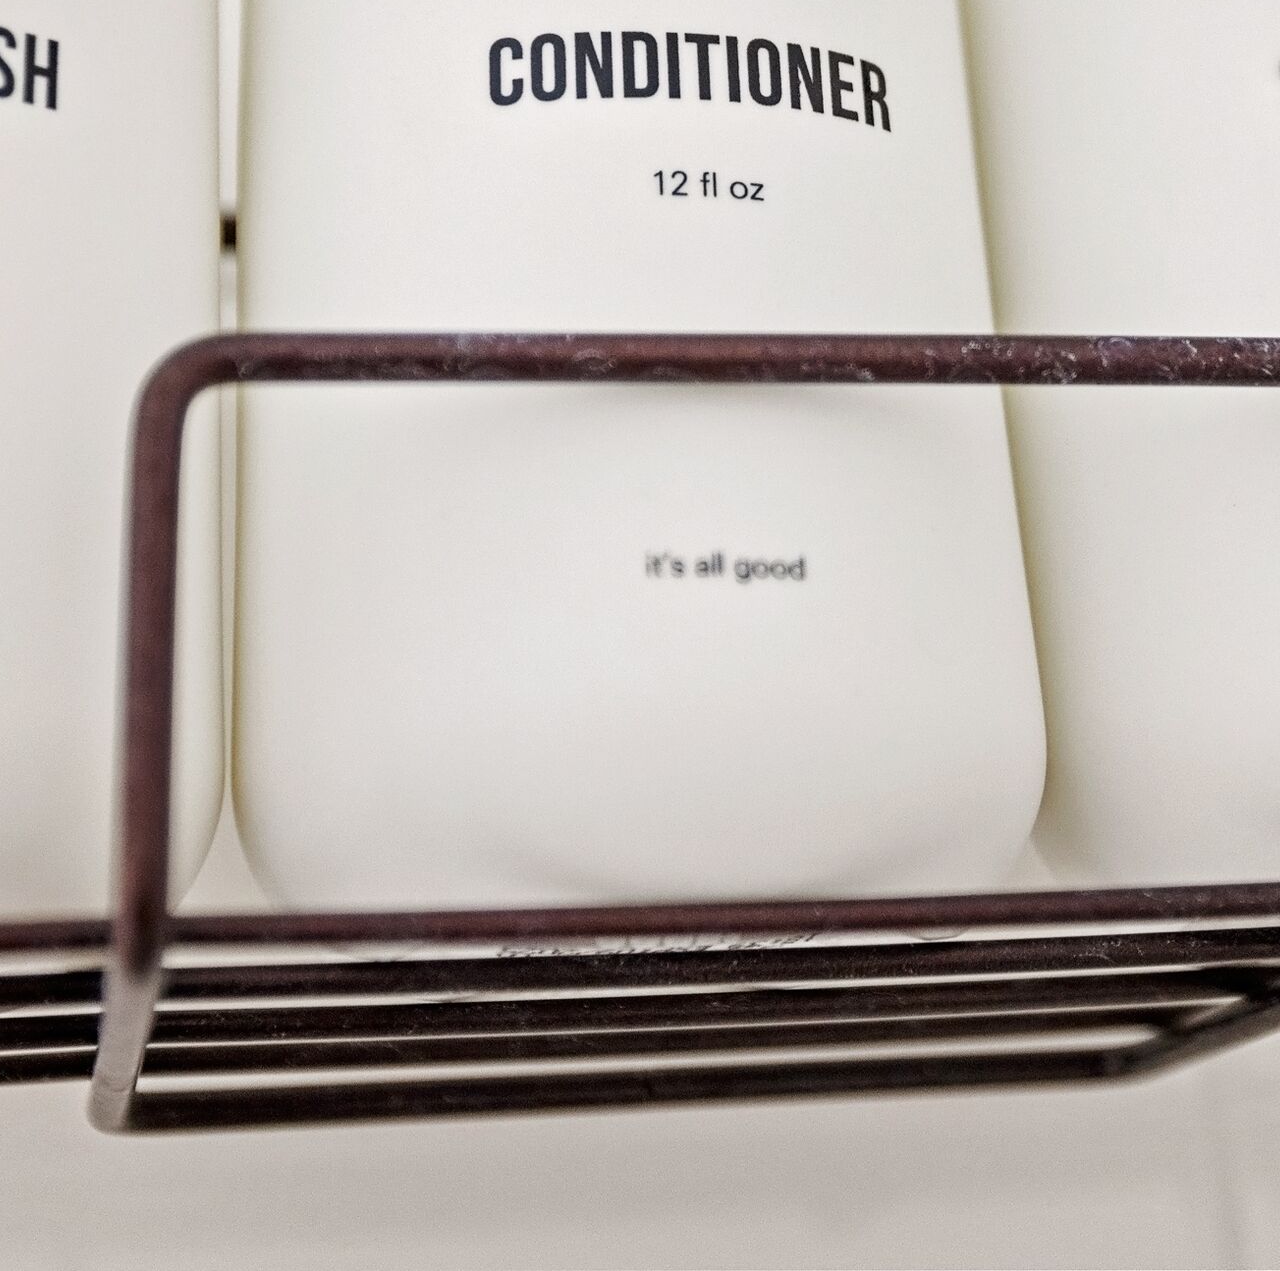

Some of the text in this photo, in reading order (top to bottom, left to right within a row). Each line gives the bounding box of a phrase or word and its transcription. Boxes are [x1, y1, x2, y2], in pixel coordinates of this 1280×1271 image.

[487, 30, 893, 133] CONDITIONER
[652, 169, 767, 203] 12 fl oz
[643, 549, 807, 585] it's all good
